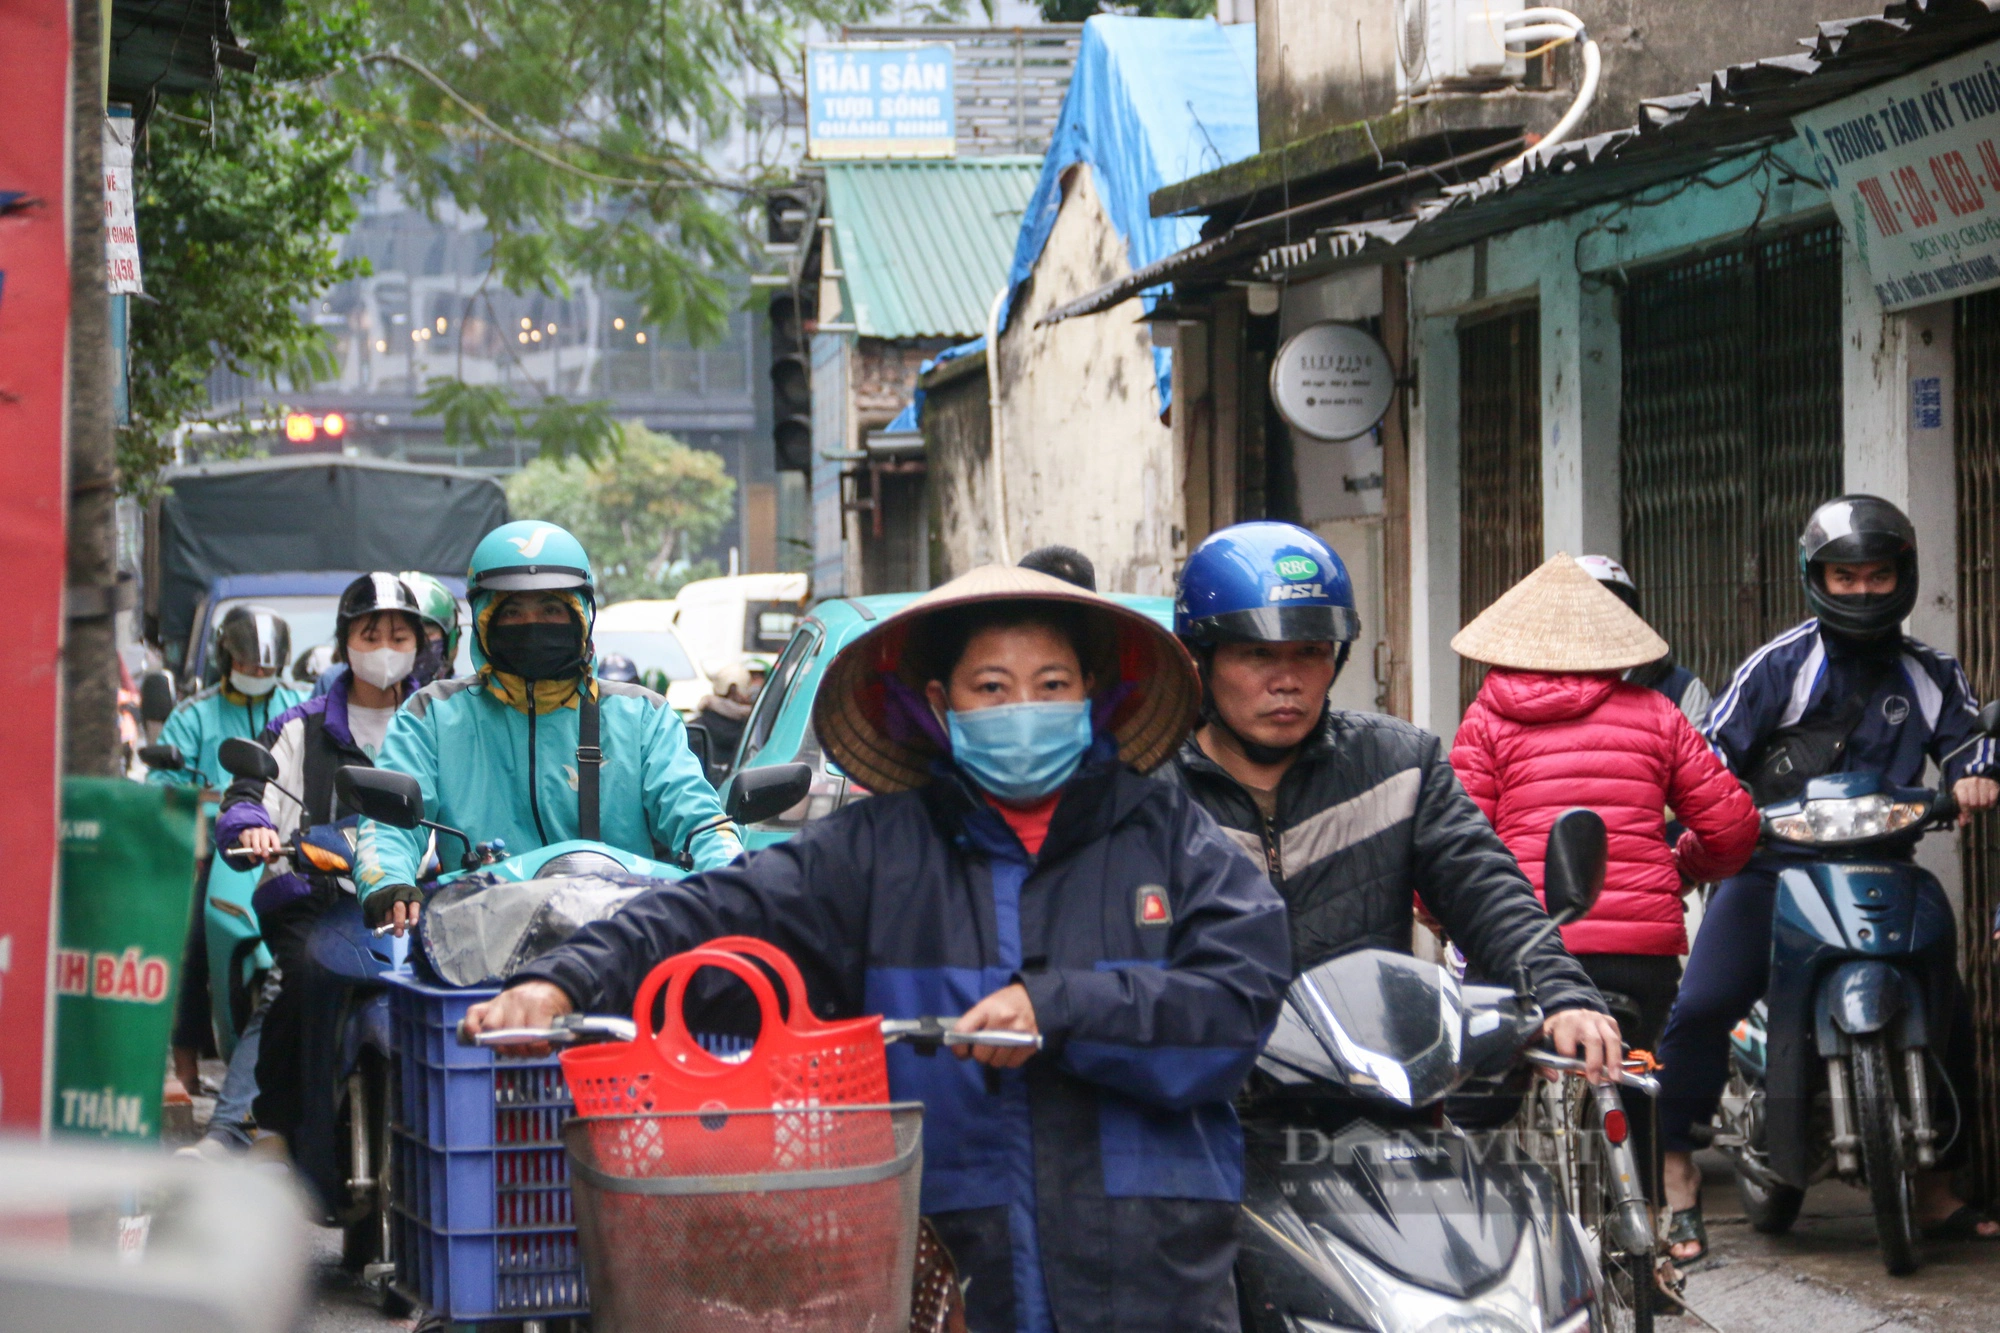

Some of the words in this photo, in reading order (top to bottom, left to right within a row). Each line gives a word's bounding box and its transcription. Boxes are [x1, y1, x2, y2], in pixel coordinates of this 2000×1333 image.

[816, 52, 870, 92] HẢI
[880, 51, 946, 93] SẢN
[1823, 112, 1888, 166] TRUNG
[1879, 96, 1930, 148] TÂM
[1921, 80, 1955, 134] KỸ
[1857, 176, 1903, 238] TIVI
[1890, 165, 1938, 229] LCD
[1928, 149, 1985, 217] OLED
[1909, 240, 1938, 264] DỊCH
[1278, 559, 1314, 576] RBC
[93, 946, 169, 1004] BÁO
